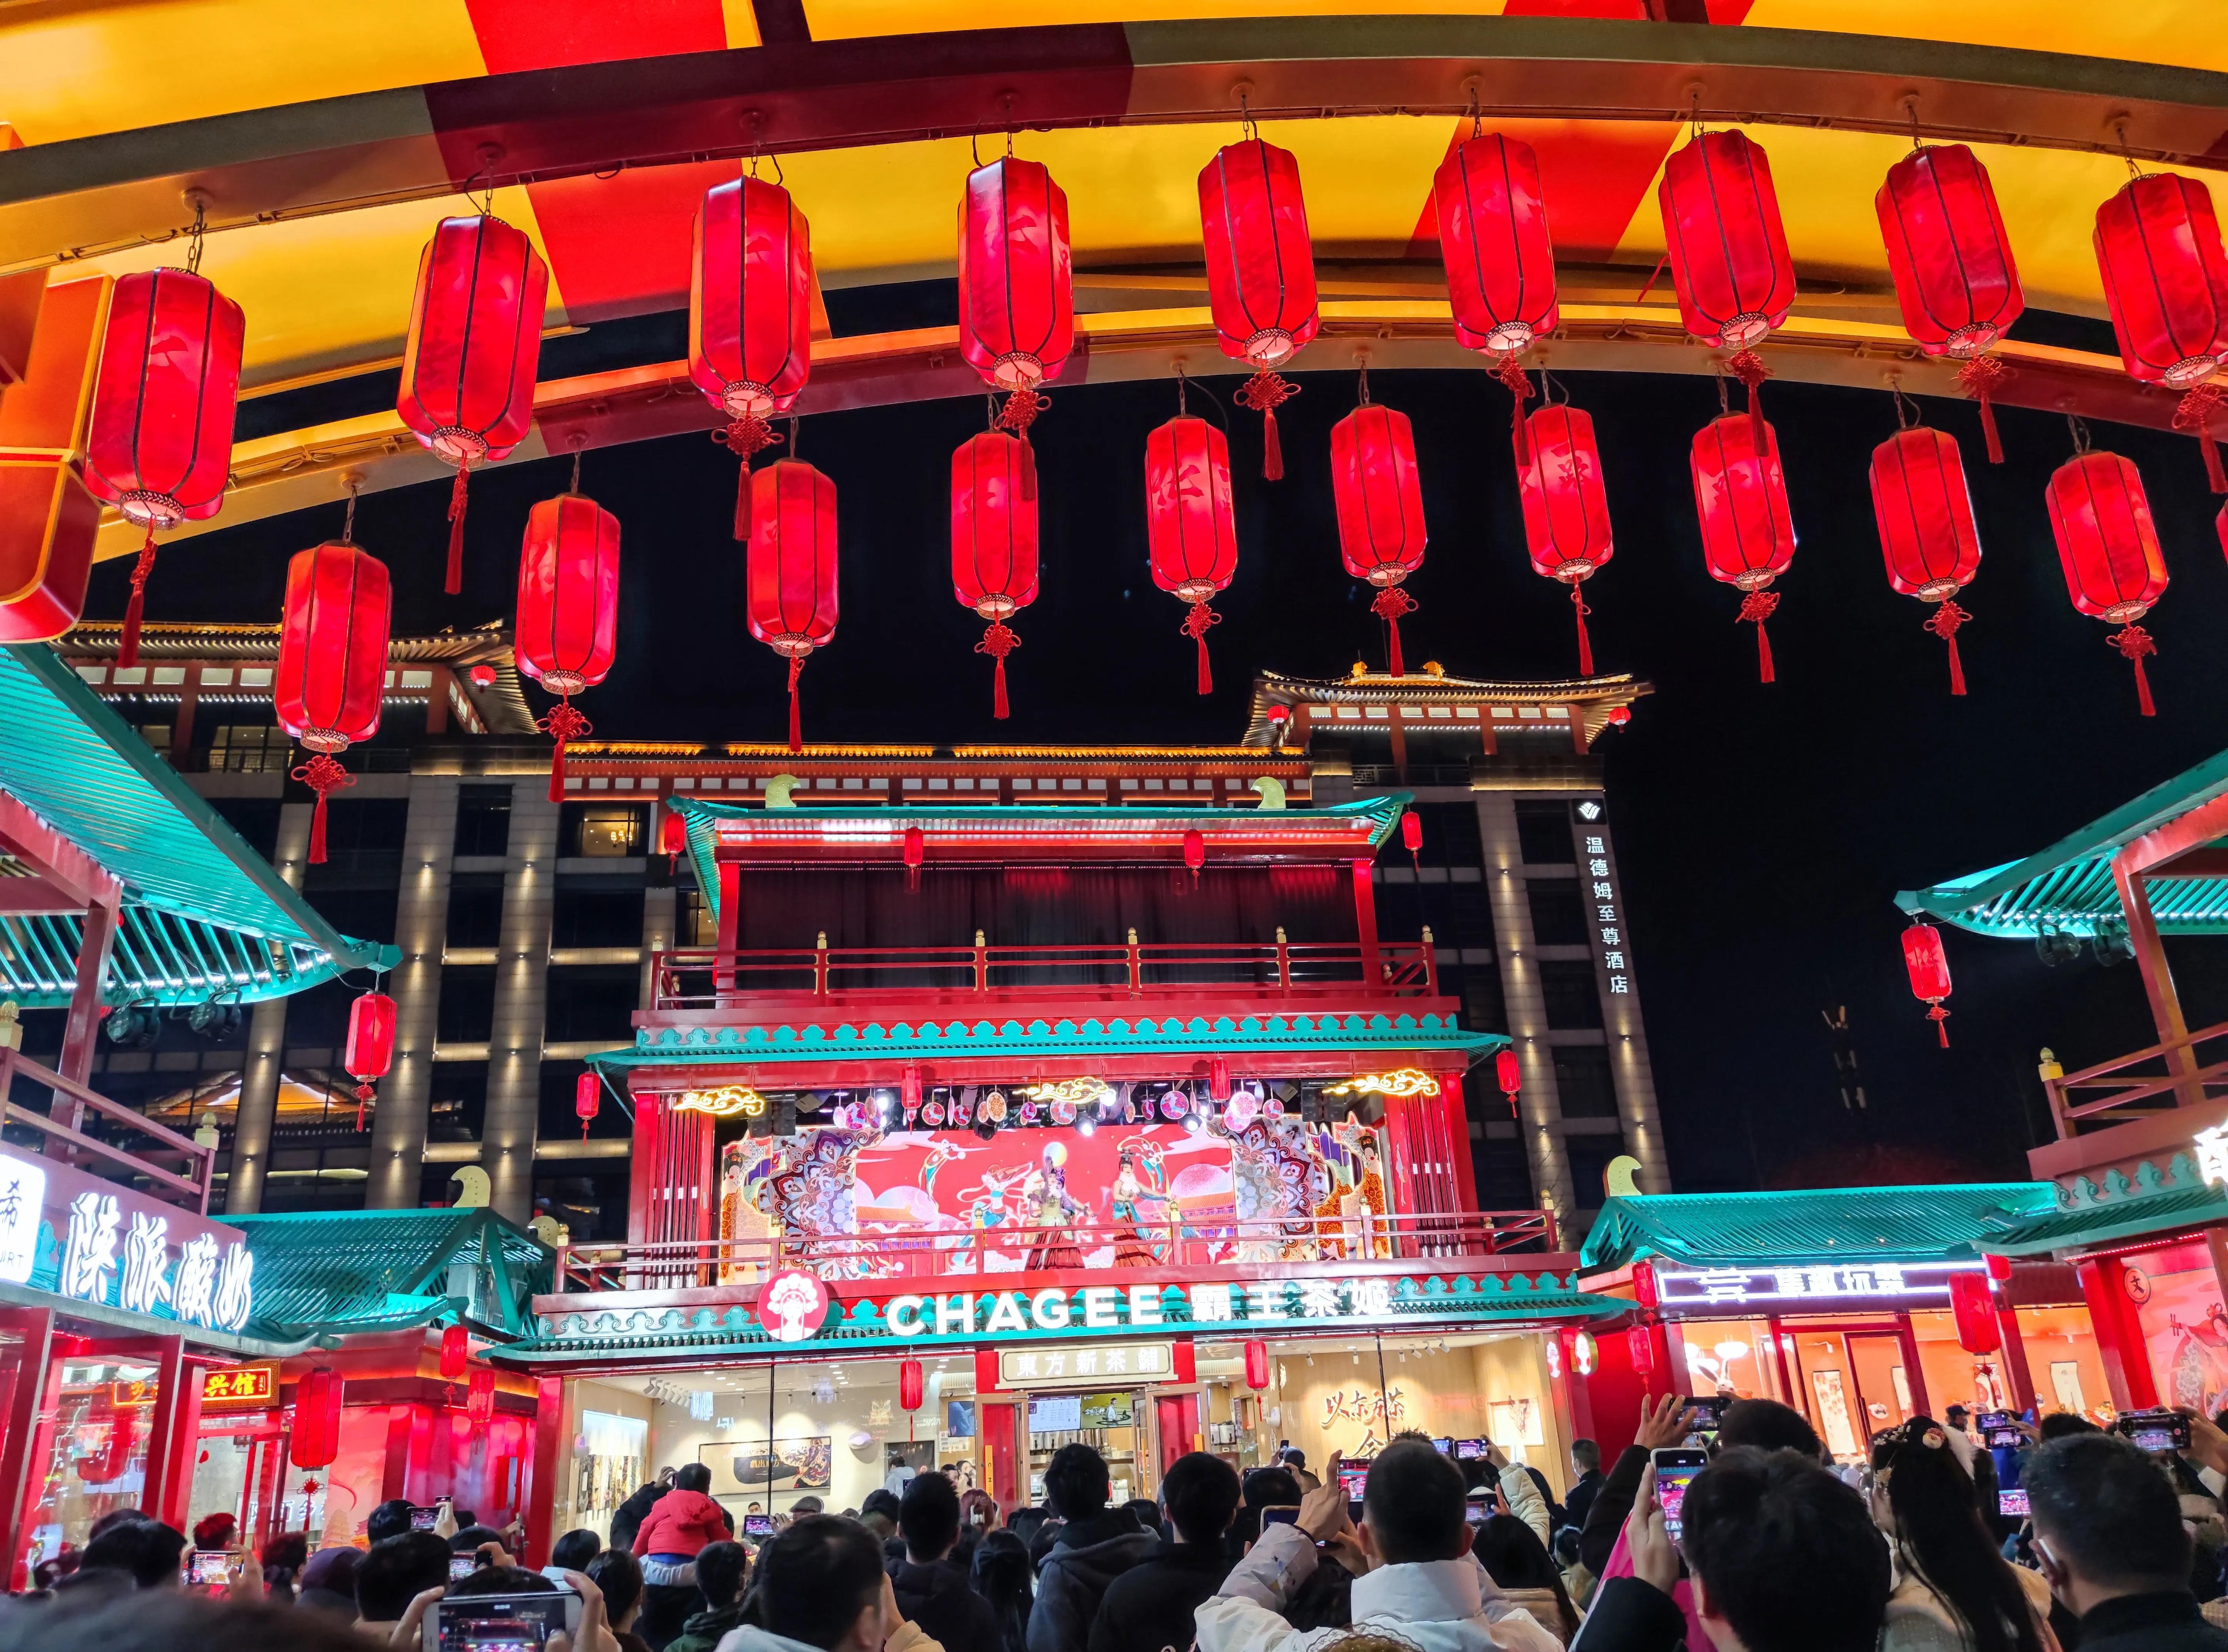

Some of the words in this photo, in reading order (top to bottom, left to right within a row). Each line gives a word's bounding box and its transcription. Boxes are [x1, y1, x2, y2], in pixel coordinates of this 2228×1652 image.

[1585, 836, 1628, 994] 温德姆至尊酒店
[886, 1286, 1164, 1336] CHAGEE
[1189, 1279, 1392, 1322] 霸王茶姬
[1016, 1348, 1159, 1377] 東方新茶鋪
